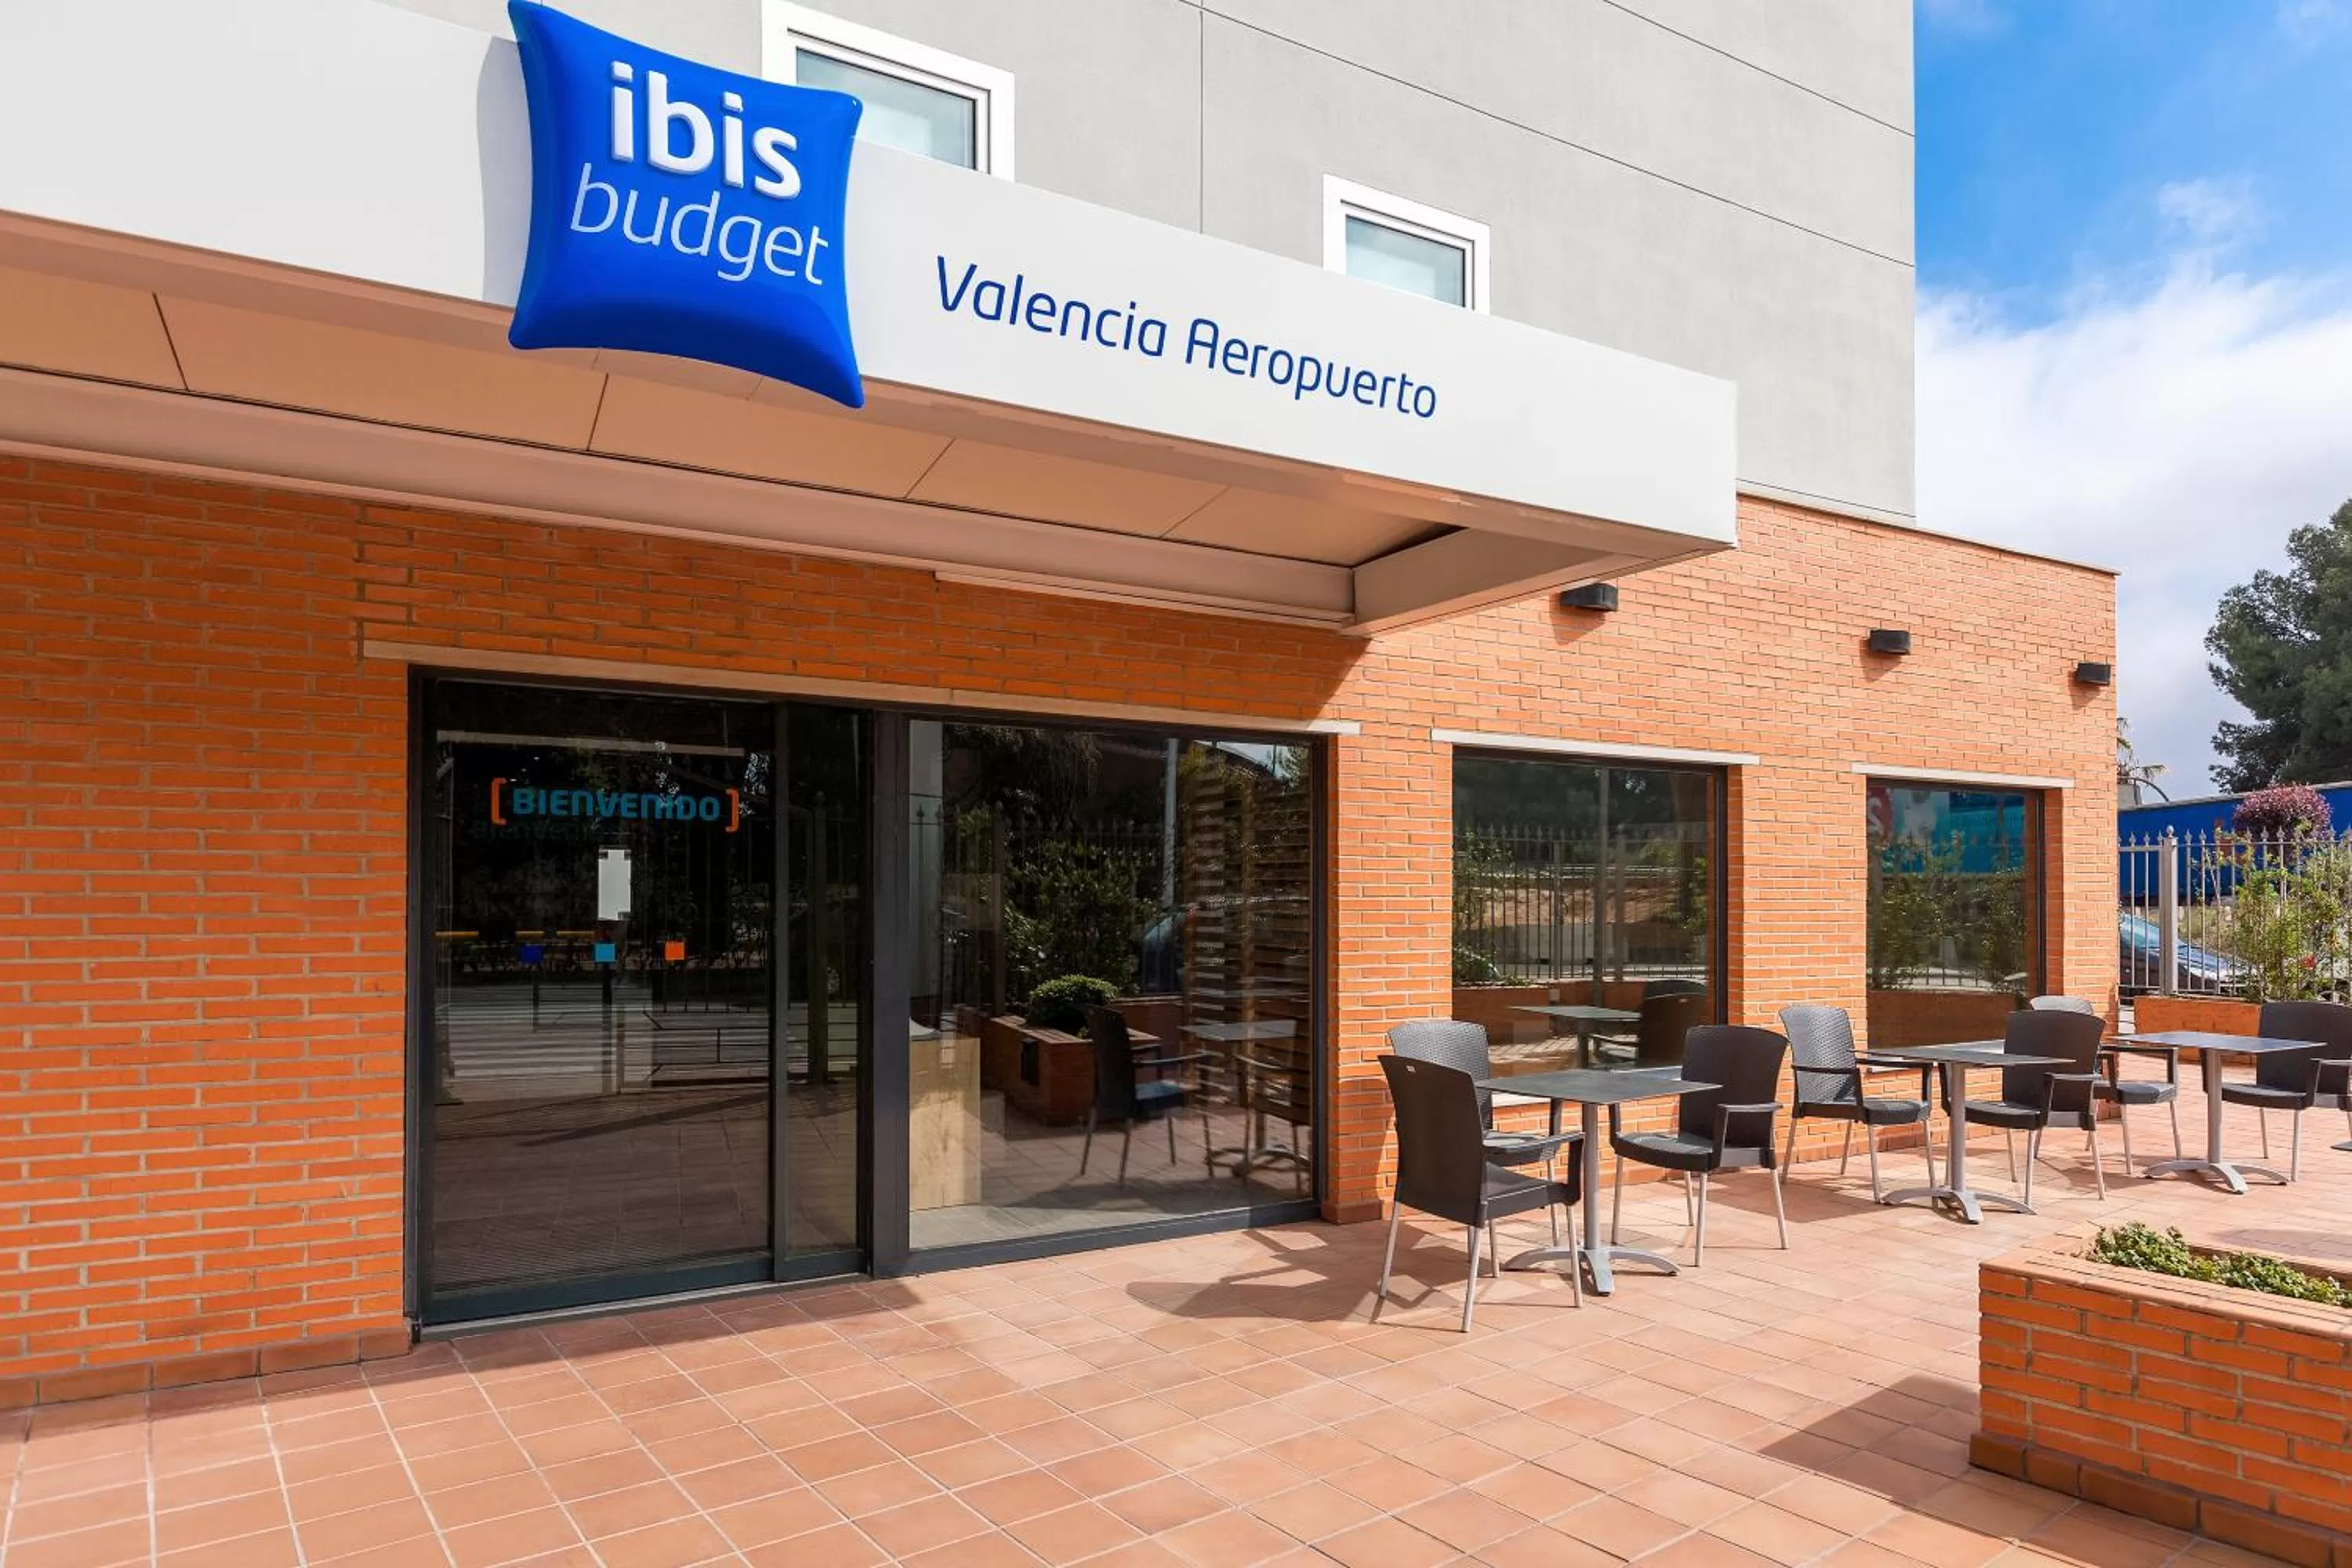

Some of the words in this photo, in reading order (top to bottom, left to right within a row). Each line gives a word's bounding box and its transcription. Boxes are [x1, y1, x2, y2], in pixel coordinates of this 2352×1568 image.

[611, 60, 801, 200] ibis
[570, 162, 829, 285] budget
[937, 256, 1167, 358] Valencia
[1185, 318, 1437, 419] Aeropuerto
